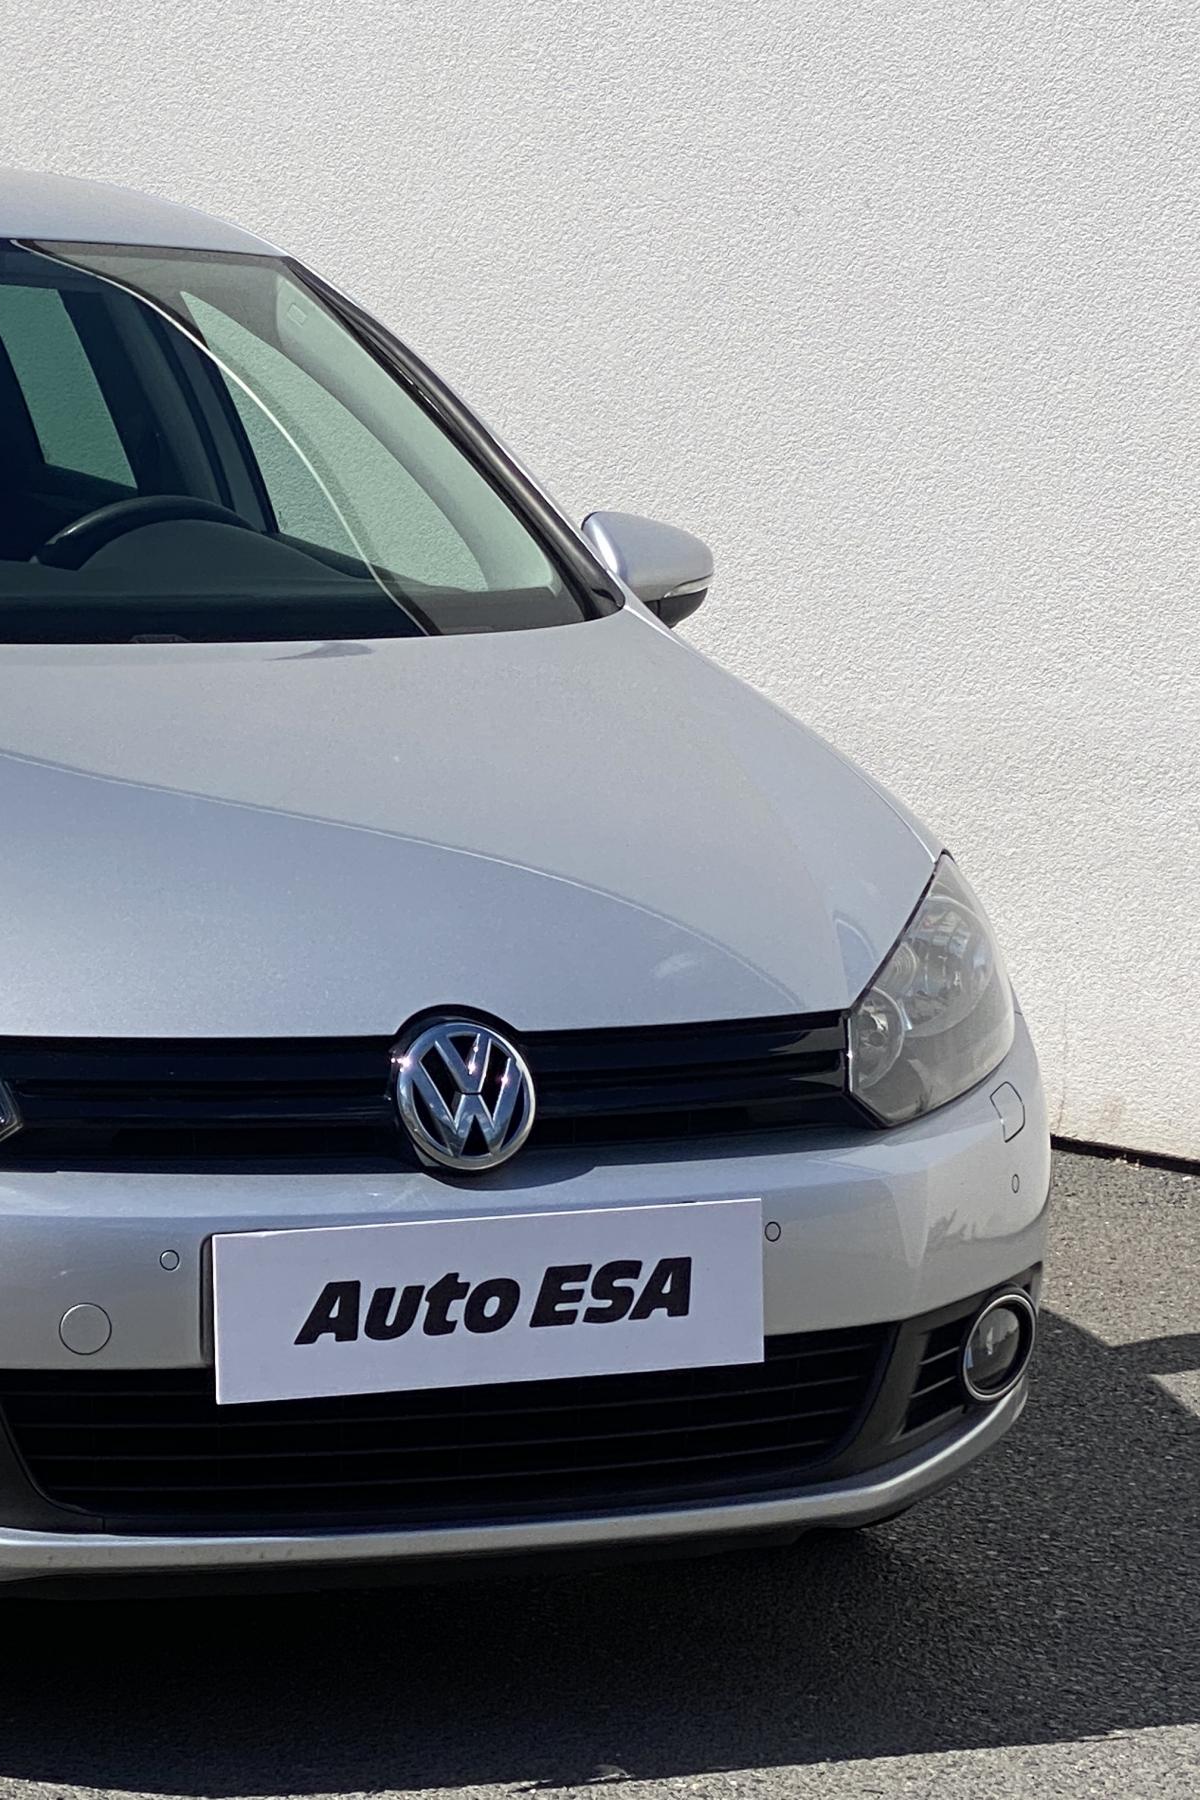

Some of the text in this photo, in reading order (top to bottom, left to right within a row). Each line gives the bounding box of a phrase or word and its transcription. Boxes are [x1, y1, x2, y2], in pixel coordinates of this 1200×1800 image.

[402, 1026, 531, 1165] VW
[293, 1256, 693, 1346] Auto ESA
